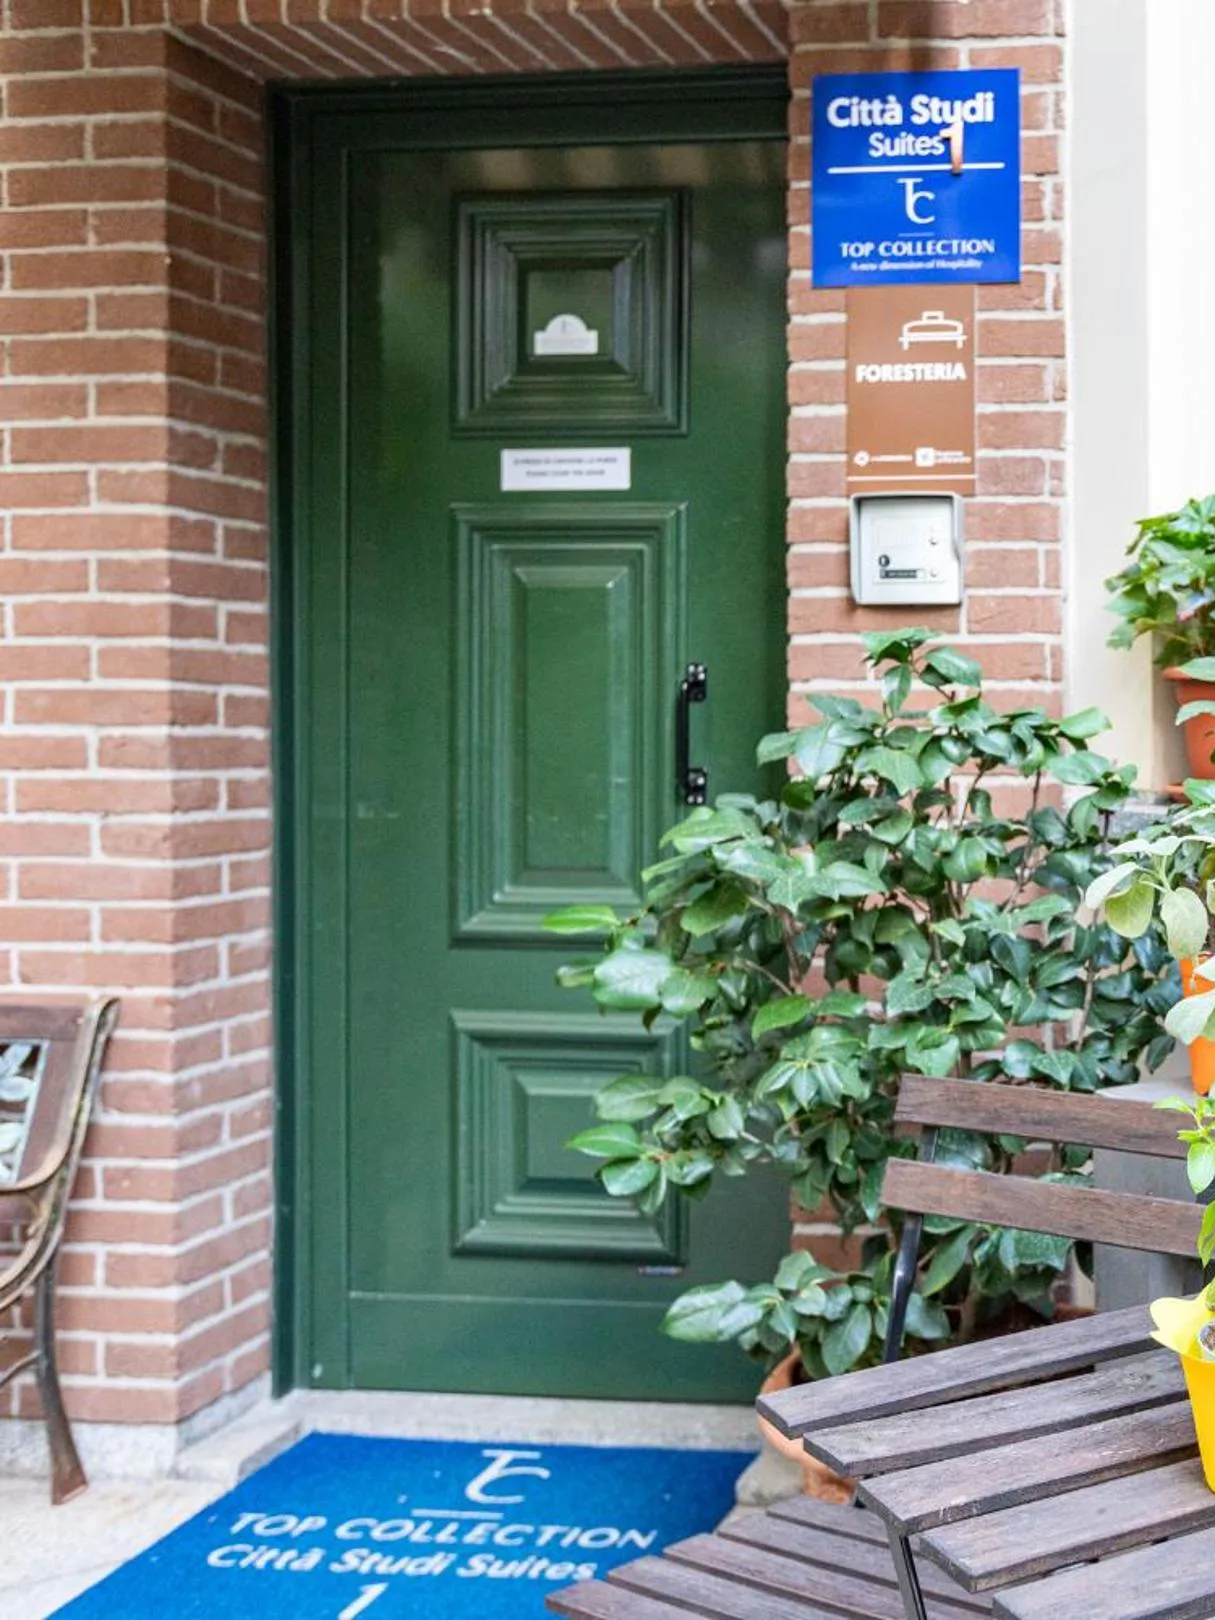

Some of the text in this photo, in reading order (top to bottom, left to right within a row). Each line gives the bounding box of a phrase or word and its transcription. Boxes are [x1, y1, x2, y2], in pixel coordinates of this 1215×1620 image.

[826, 91, 995, 128] Città Studi
[868, 121, 964, 174] Suites 1
[840, 239, 996, 258] TOP COLLECTION
[856, 362, 967, 384] FORESTERIA
[230, 1512, 657, 1549] TOP COLLECTION
[329, 1547, 458, 1577] Studi
[456, 1553, 598, 1581] Suites
[338, 1581, 390, 1620] 1
